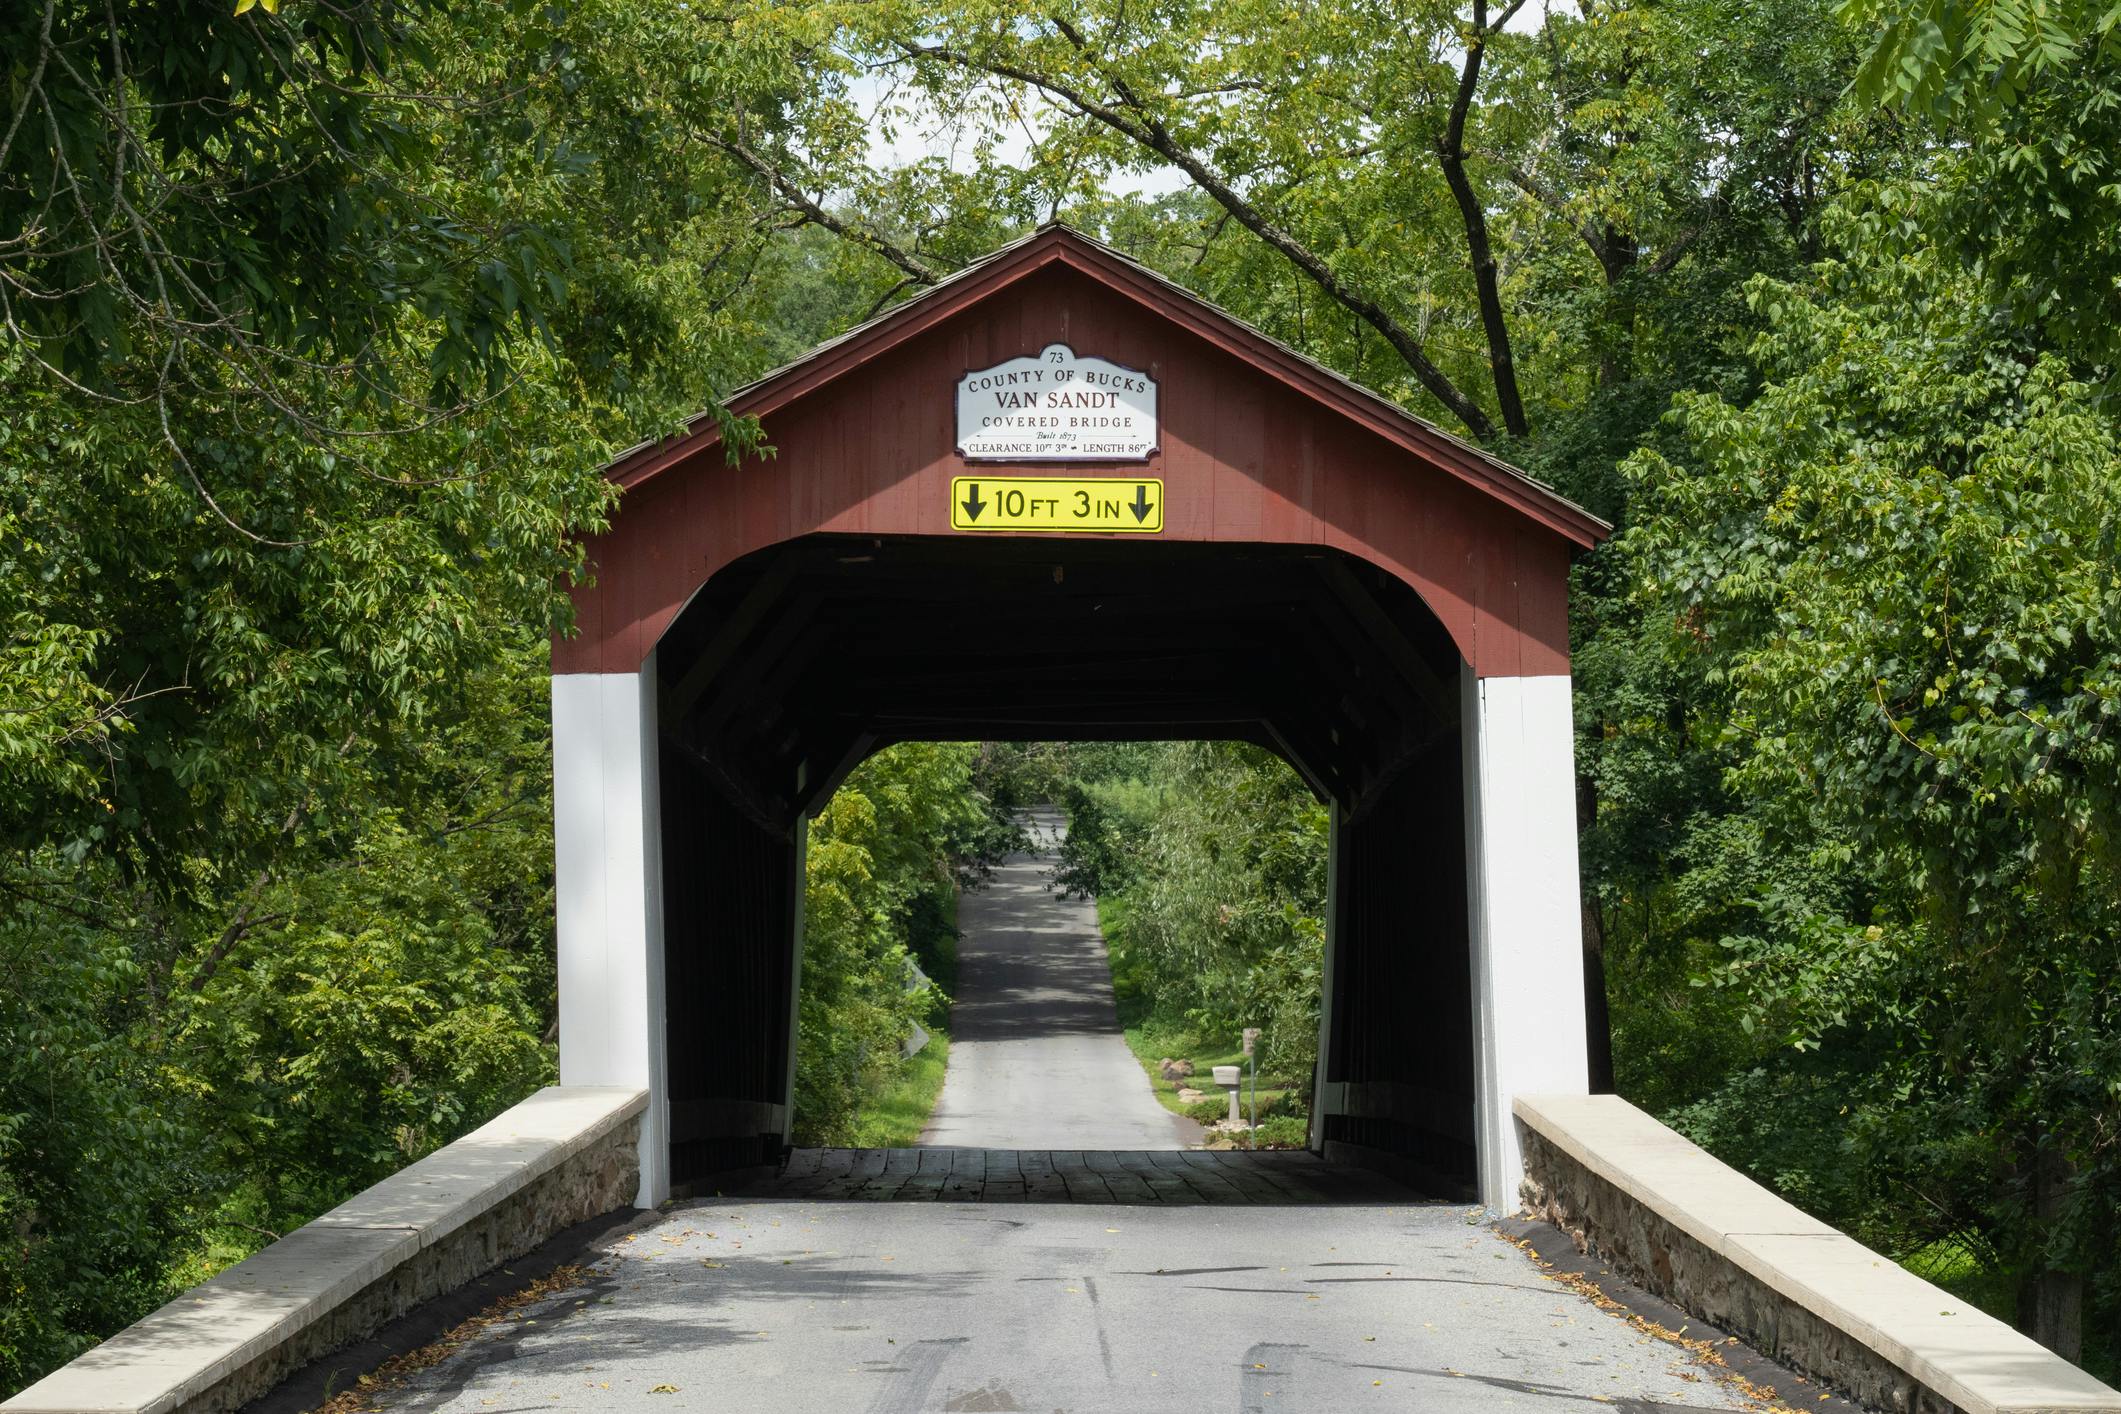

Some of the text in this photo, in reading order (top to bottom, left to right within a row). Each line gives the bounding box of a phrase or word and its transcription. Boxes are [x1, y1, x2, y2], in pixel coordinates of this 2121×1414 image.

[1050, 352, 1063, 363] 73
[968, 370, 1146, 393] COUNTY OF BUCKS
[995, 392, 1119, 408] VAN SANDT
[982, 417, 1132, 427] COVERED BRIDGE
[1036, 432, 1077, 441] Built 1873
[969, 444, 1032, 452] CLEARANCE
[1083, 444, 1125, 452] LENGTH
